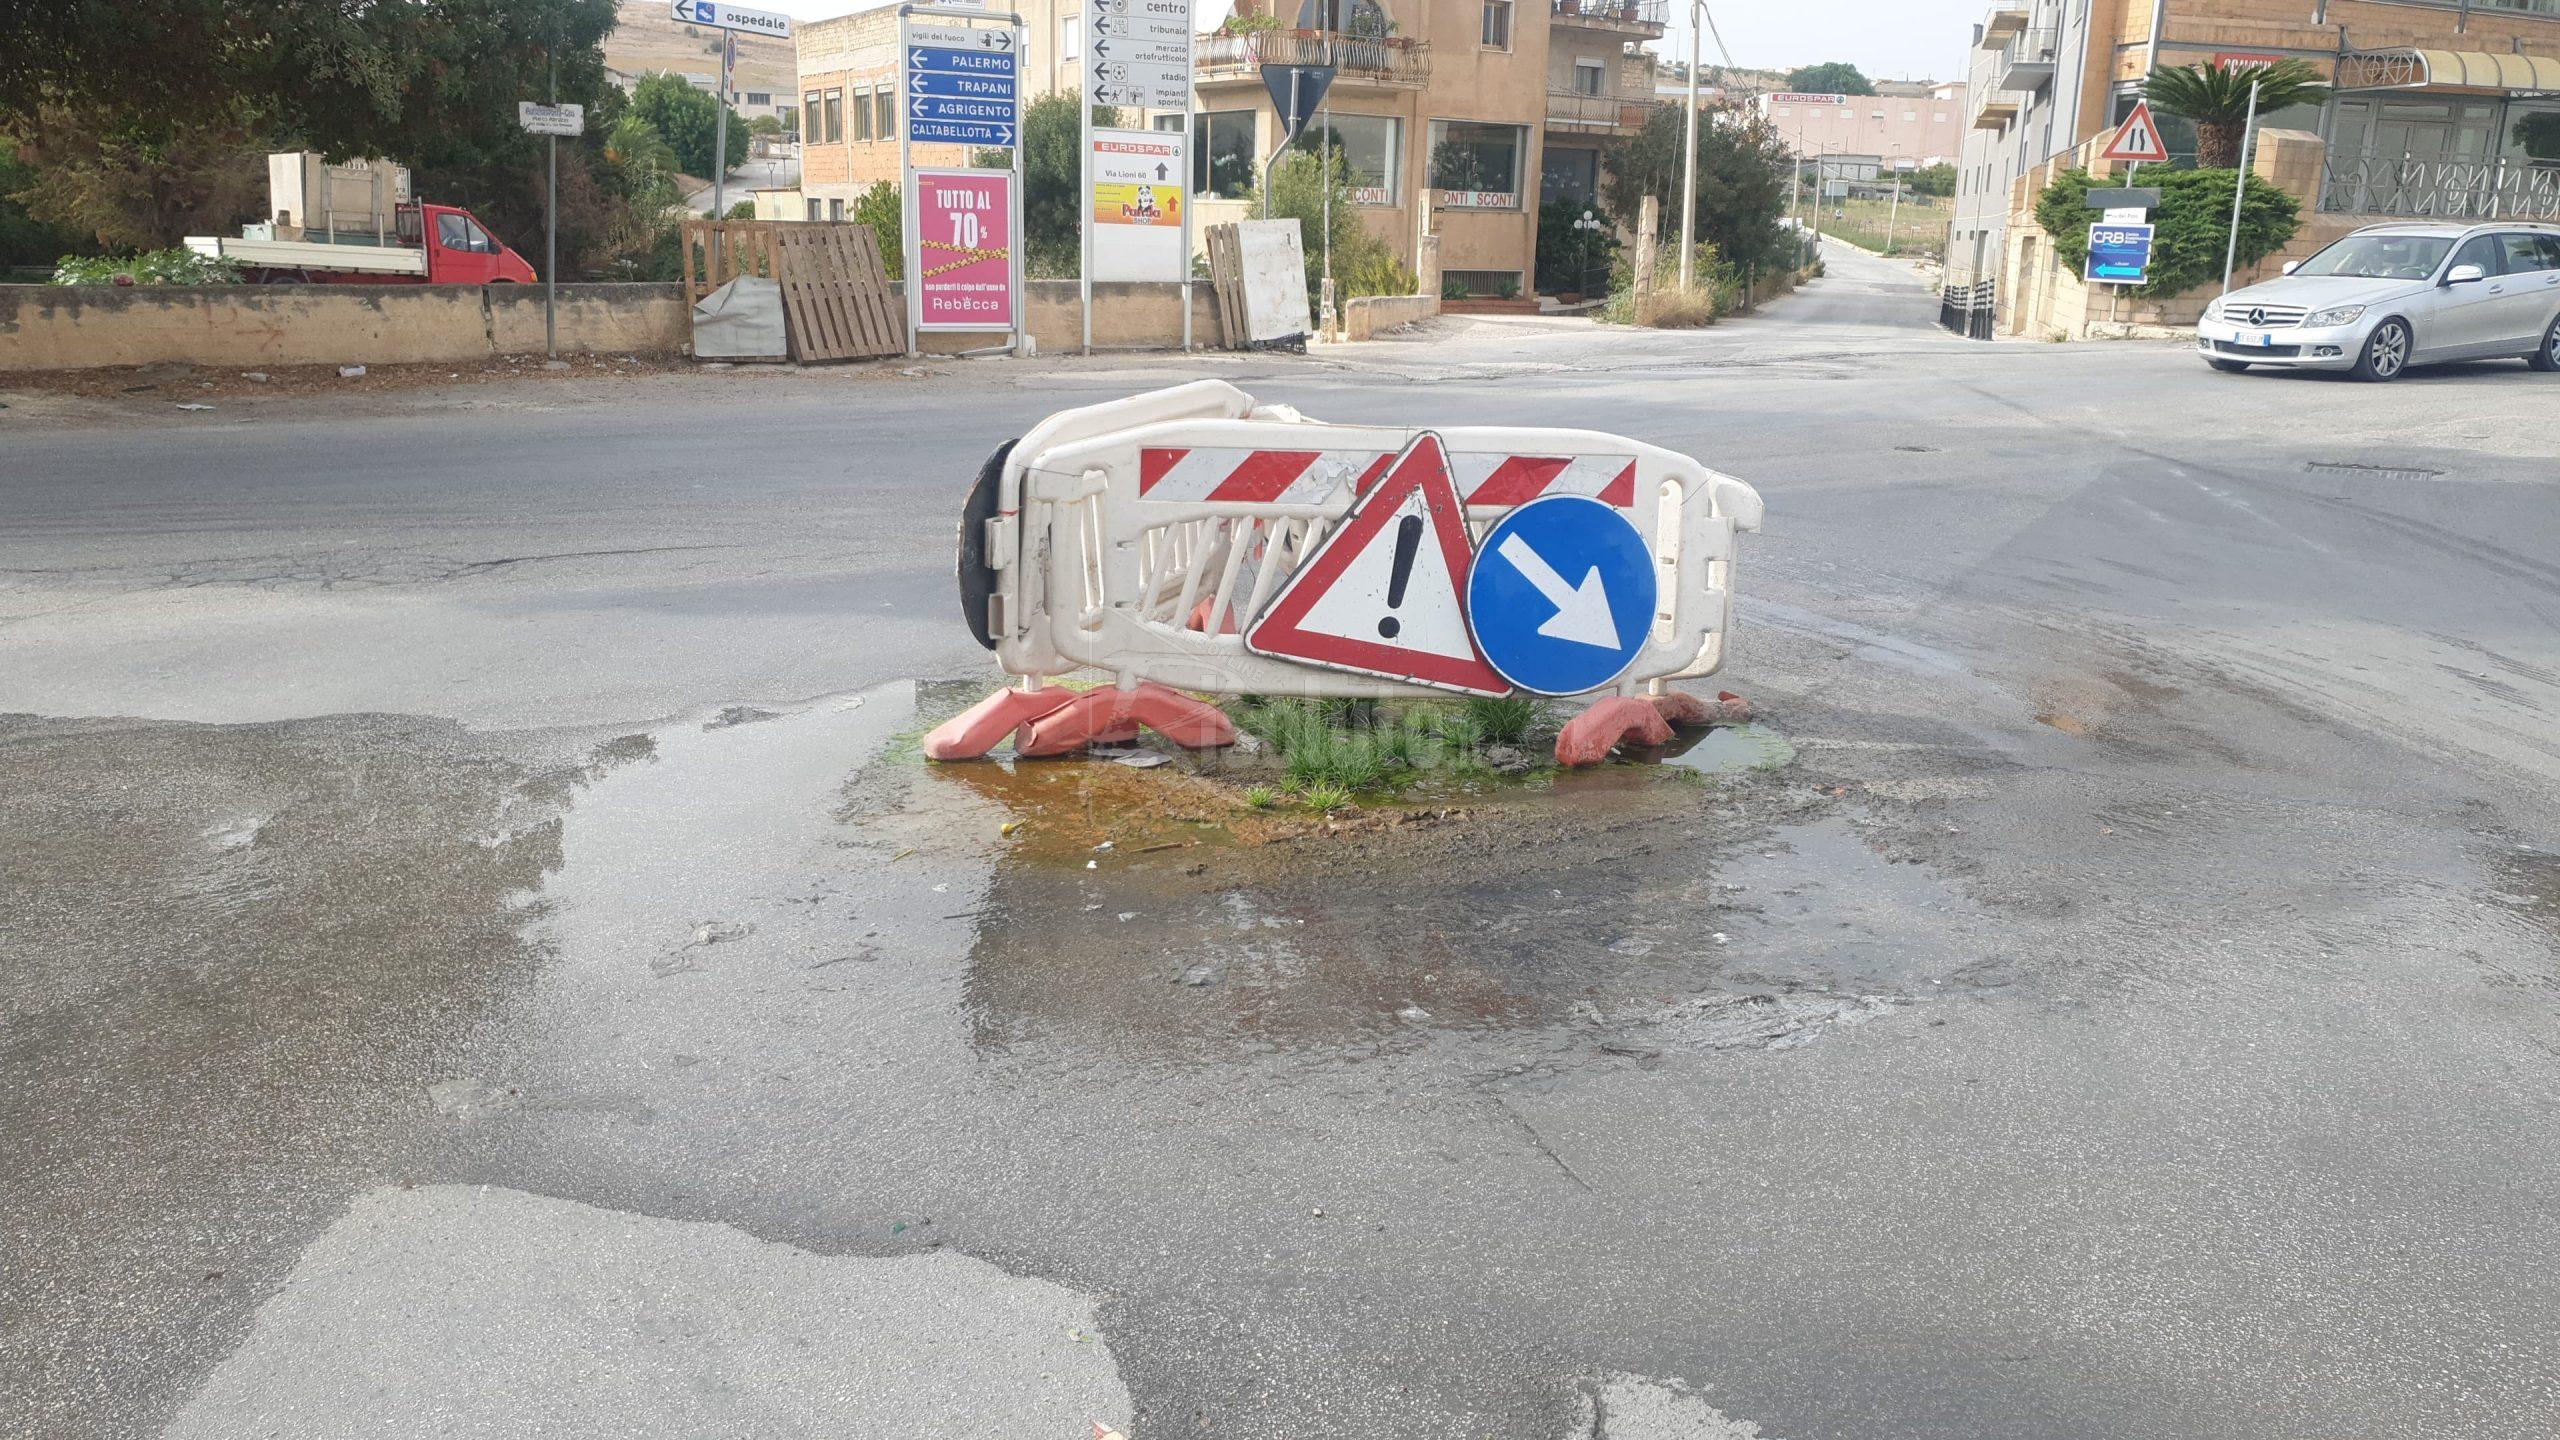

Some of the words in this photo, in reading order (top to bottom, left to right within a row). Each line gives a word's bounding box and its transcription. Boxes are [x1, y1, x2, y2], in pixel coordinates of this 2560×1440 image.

[1146, 2, 1186, 14] centro
[726, 13, 785, 30] ospedale
[1150, 25, 1187, 35] tribunale
[912, 32, 929, 40] vigili
[944, 34, 965, 42] fuoco
[1156, 45, 1186, 53] mercato
[952, 56, 1010, 70] PALERMO
[1135, 53, 1186, 62] ortofrutticolo
[1161, 73, 1186, 82] stadio
[958, 81, 1011, 94] TRAPANI
[1156, 88, 1186, 98] impianti
[1158, 99, 1186, 107] sportivi
[1777, 94, 1835, 103] EUROSPAR
[938, 103, 1011, 117] AGRIGENTO
[912, 124, 992, 139] CALTABELLOTTA
[1102, 142, 1170, 154] EUROSPAR
[1118, 170, 1136, 178] Lioni
[936, 189, 974, 209] TUTTO
[977, 191, 991, 210] AL
[1346, 188, 1389, 203] SCONTI
[1444, 192, 1468, 205] ONTI
[1477, 193, 1516, 206] SCONTI
[1122, 203, 1161, 218] Panda
[950, 212, 979, 249] 70
[2093, 231, 2125, 244] CRB
[933, 297, 999, 310] Rebecca
